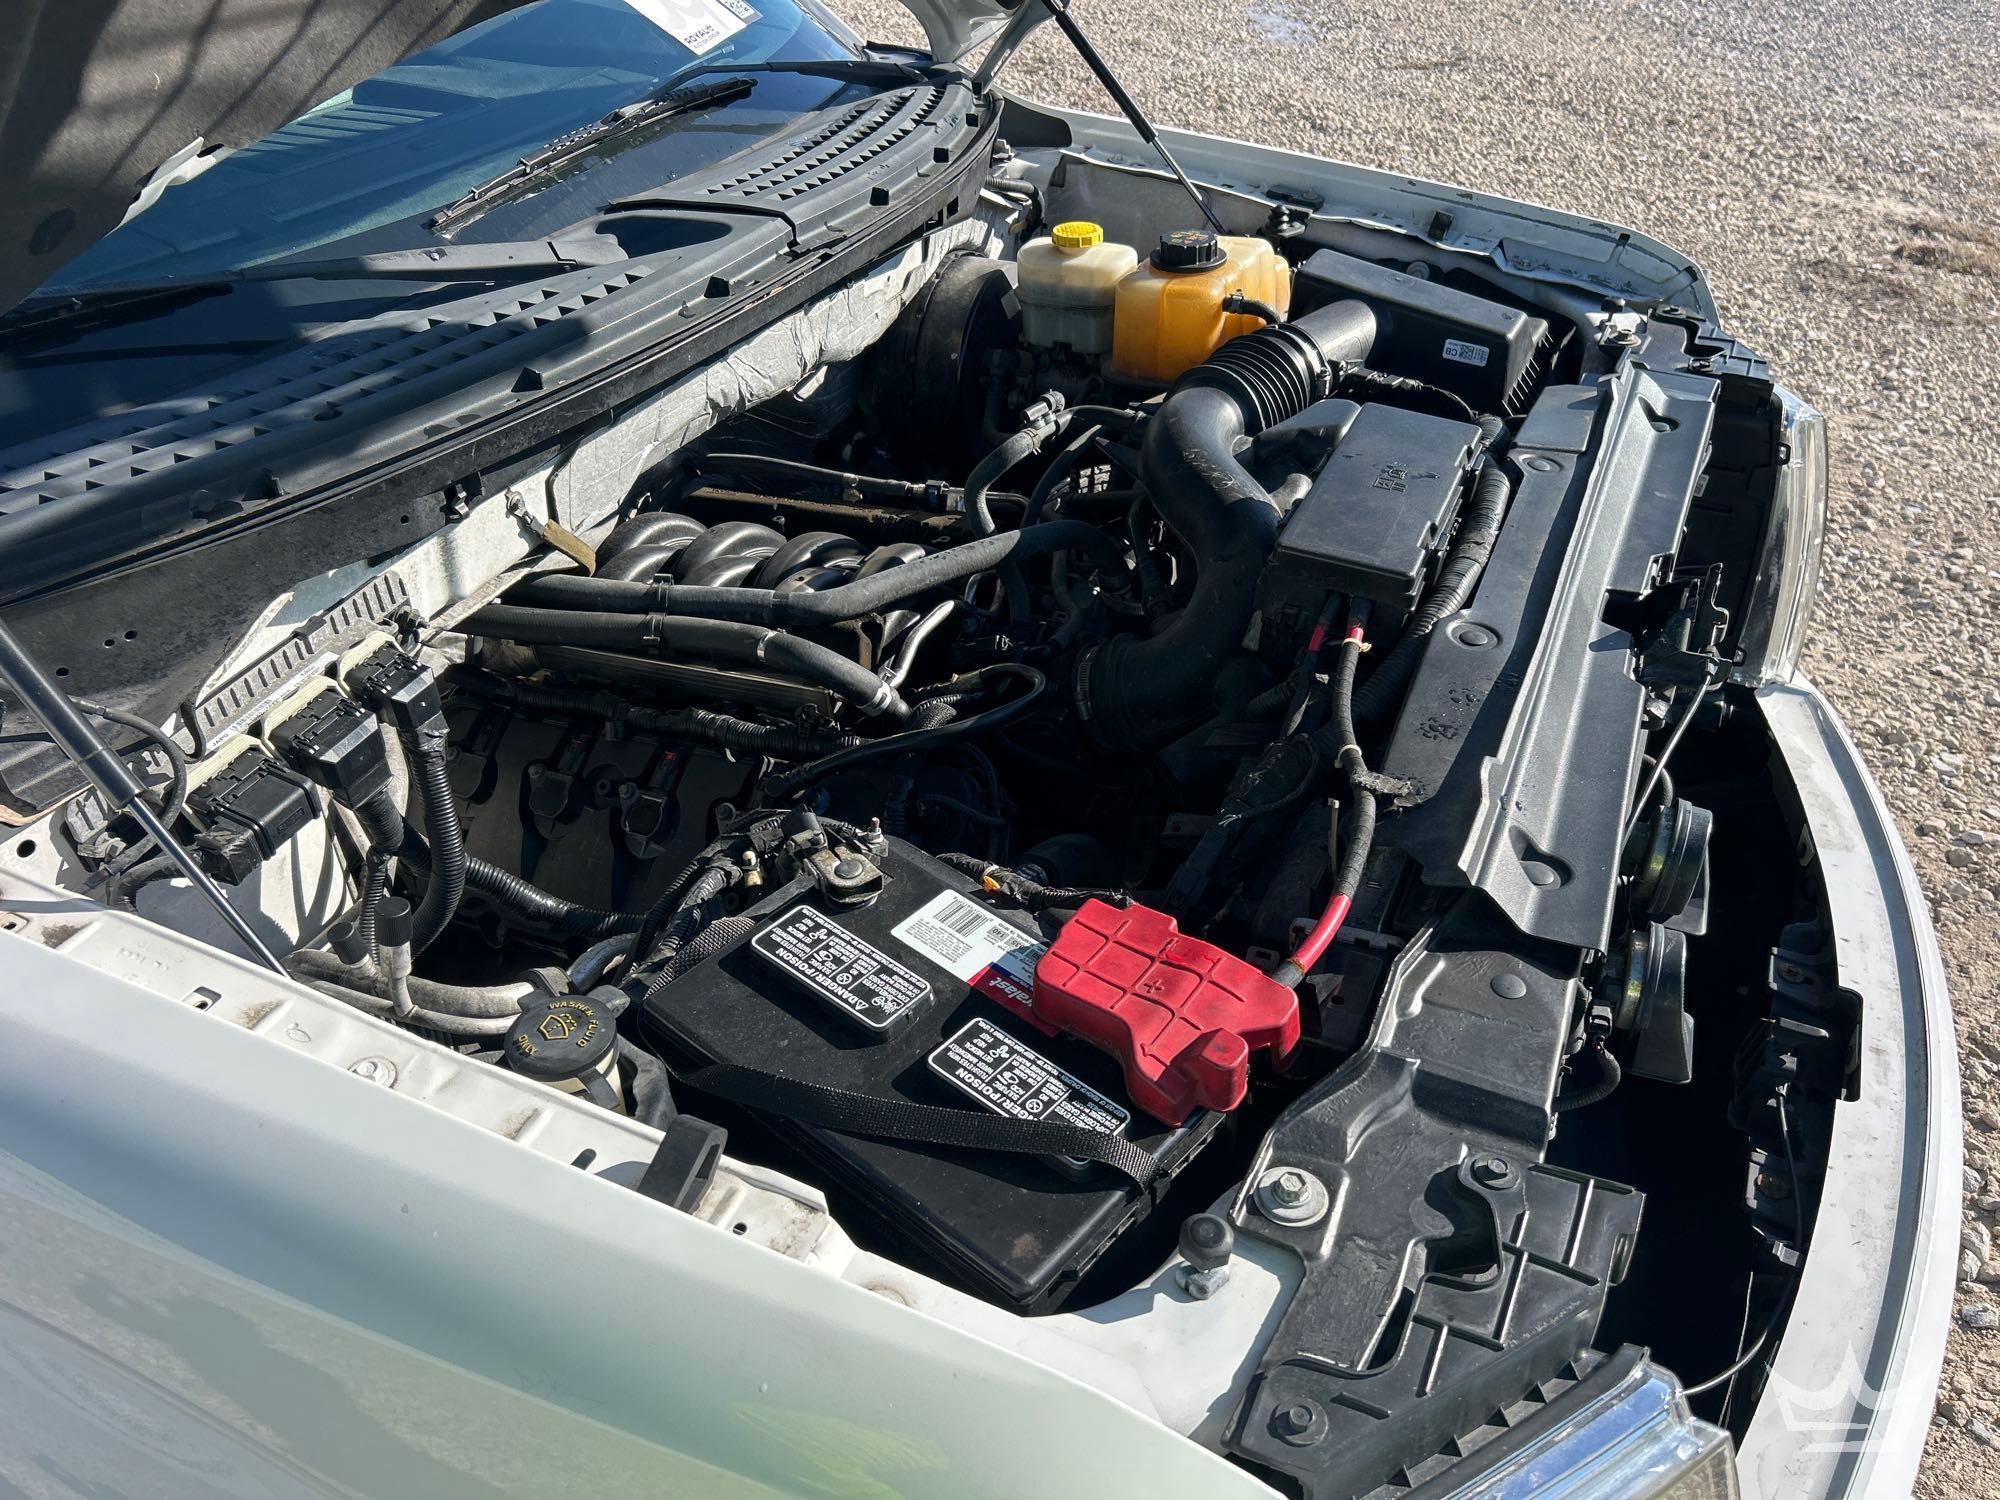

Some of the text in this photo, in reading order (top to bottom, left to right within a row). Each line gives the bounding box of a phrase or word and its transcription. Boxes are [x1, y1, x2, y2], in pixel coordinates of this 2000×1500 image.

[684, 28, 710, 44] ROYAL
[794, 921, 808, 931] HELP
[801, 917, 815, 927] FAST
[990, 927, 1006, 938] 140
[779, 939, 793, 949] EYES
[801, 935, 813, 943] GET
[789, 946, 806, 957] FLUSH
[807, 957, 832, 974] SULFURIC
[823, 960, 838, 970] ACID
[848, 967, 859, 975] NO
[774, 947, 859, 1004] DANGER/POISON
[861, 978, 894, 999] SHIELD EYES
[867, 974, 910, 1002] EXPLOSIVE GASES
[548, 1001, 599, 1048] WASHER FLUID
[971, 1036, 987, 1048] HELP
[978, 1031, 994, 1043] FAST
[518, 1034, 538, 1056] ONLY
[958, 1057, 974, 1069] EYES
[981, 1053, 994, 1063] GET
[970, 1065, 989, 1079] FLUSH
[991, 1080, 1020, 1100] SULFURIC
[1009, 1083, 1026, 1095] ACID
[1037, 1092, 1049, 1102] NO
[1053, 1105, 1071, 1118] EYES
[1059, 1100, 1080, 1116] GASES
